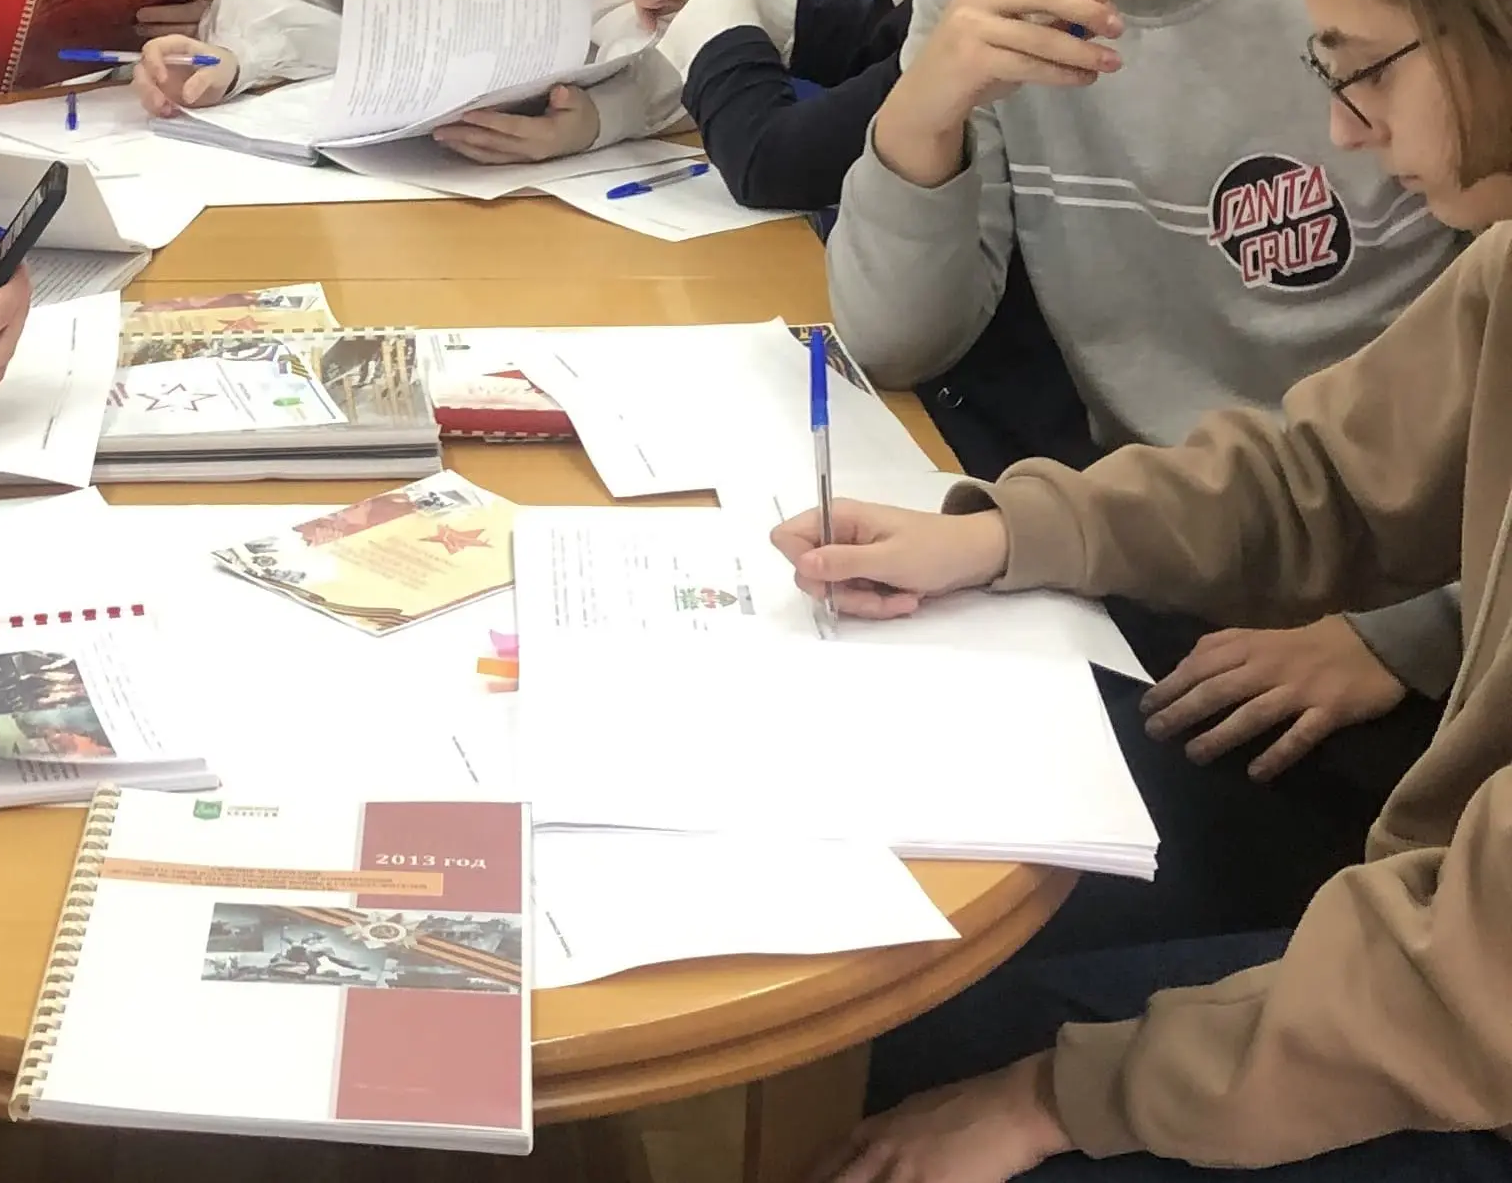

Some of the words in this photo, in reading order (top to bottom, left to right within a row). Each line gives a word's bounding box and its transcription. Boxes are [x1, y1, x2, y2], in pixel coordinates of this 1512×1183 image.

[1209, 165, 1332, 244] SANTA
[1240, 216, 1337, 286] CRUZ
[375, 853, 436, 867] 2013
[443, 857, 487, 870] год
